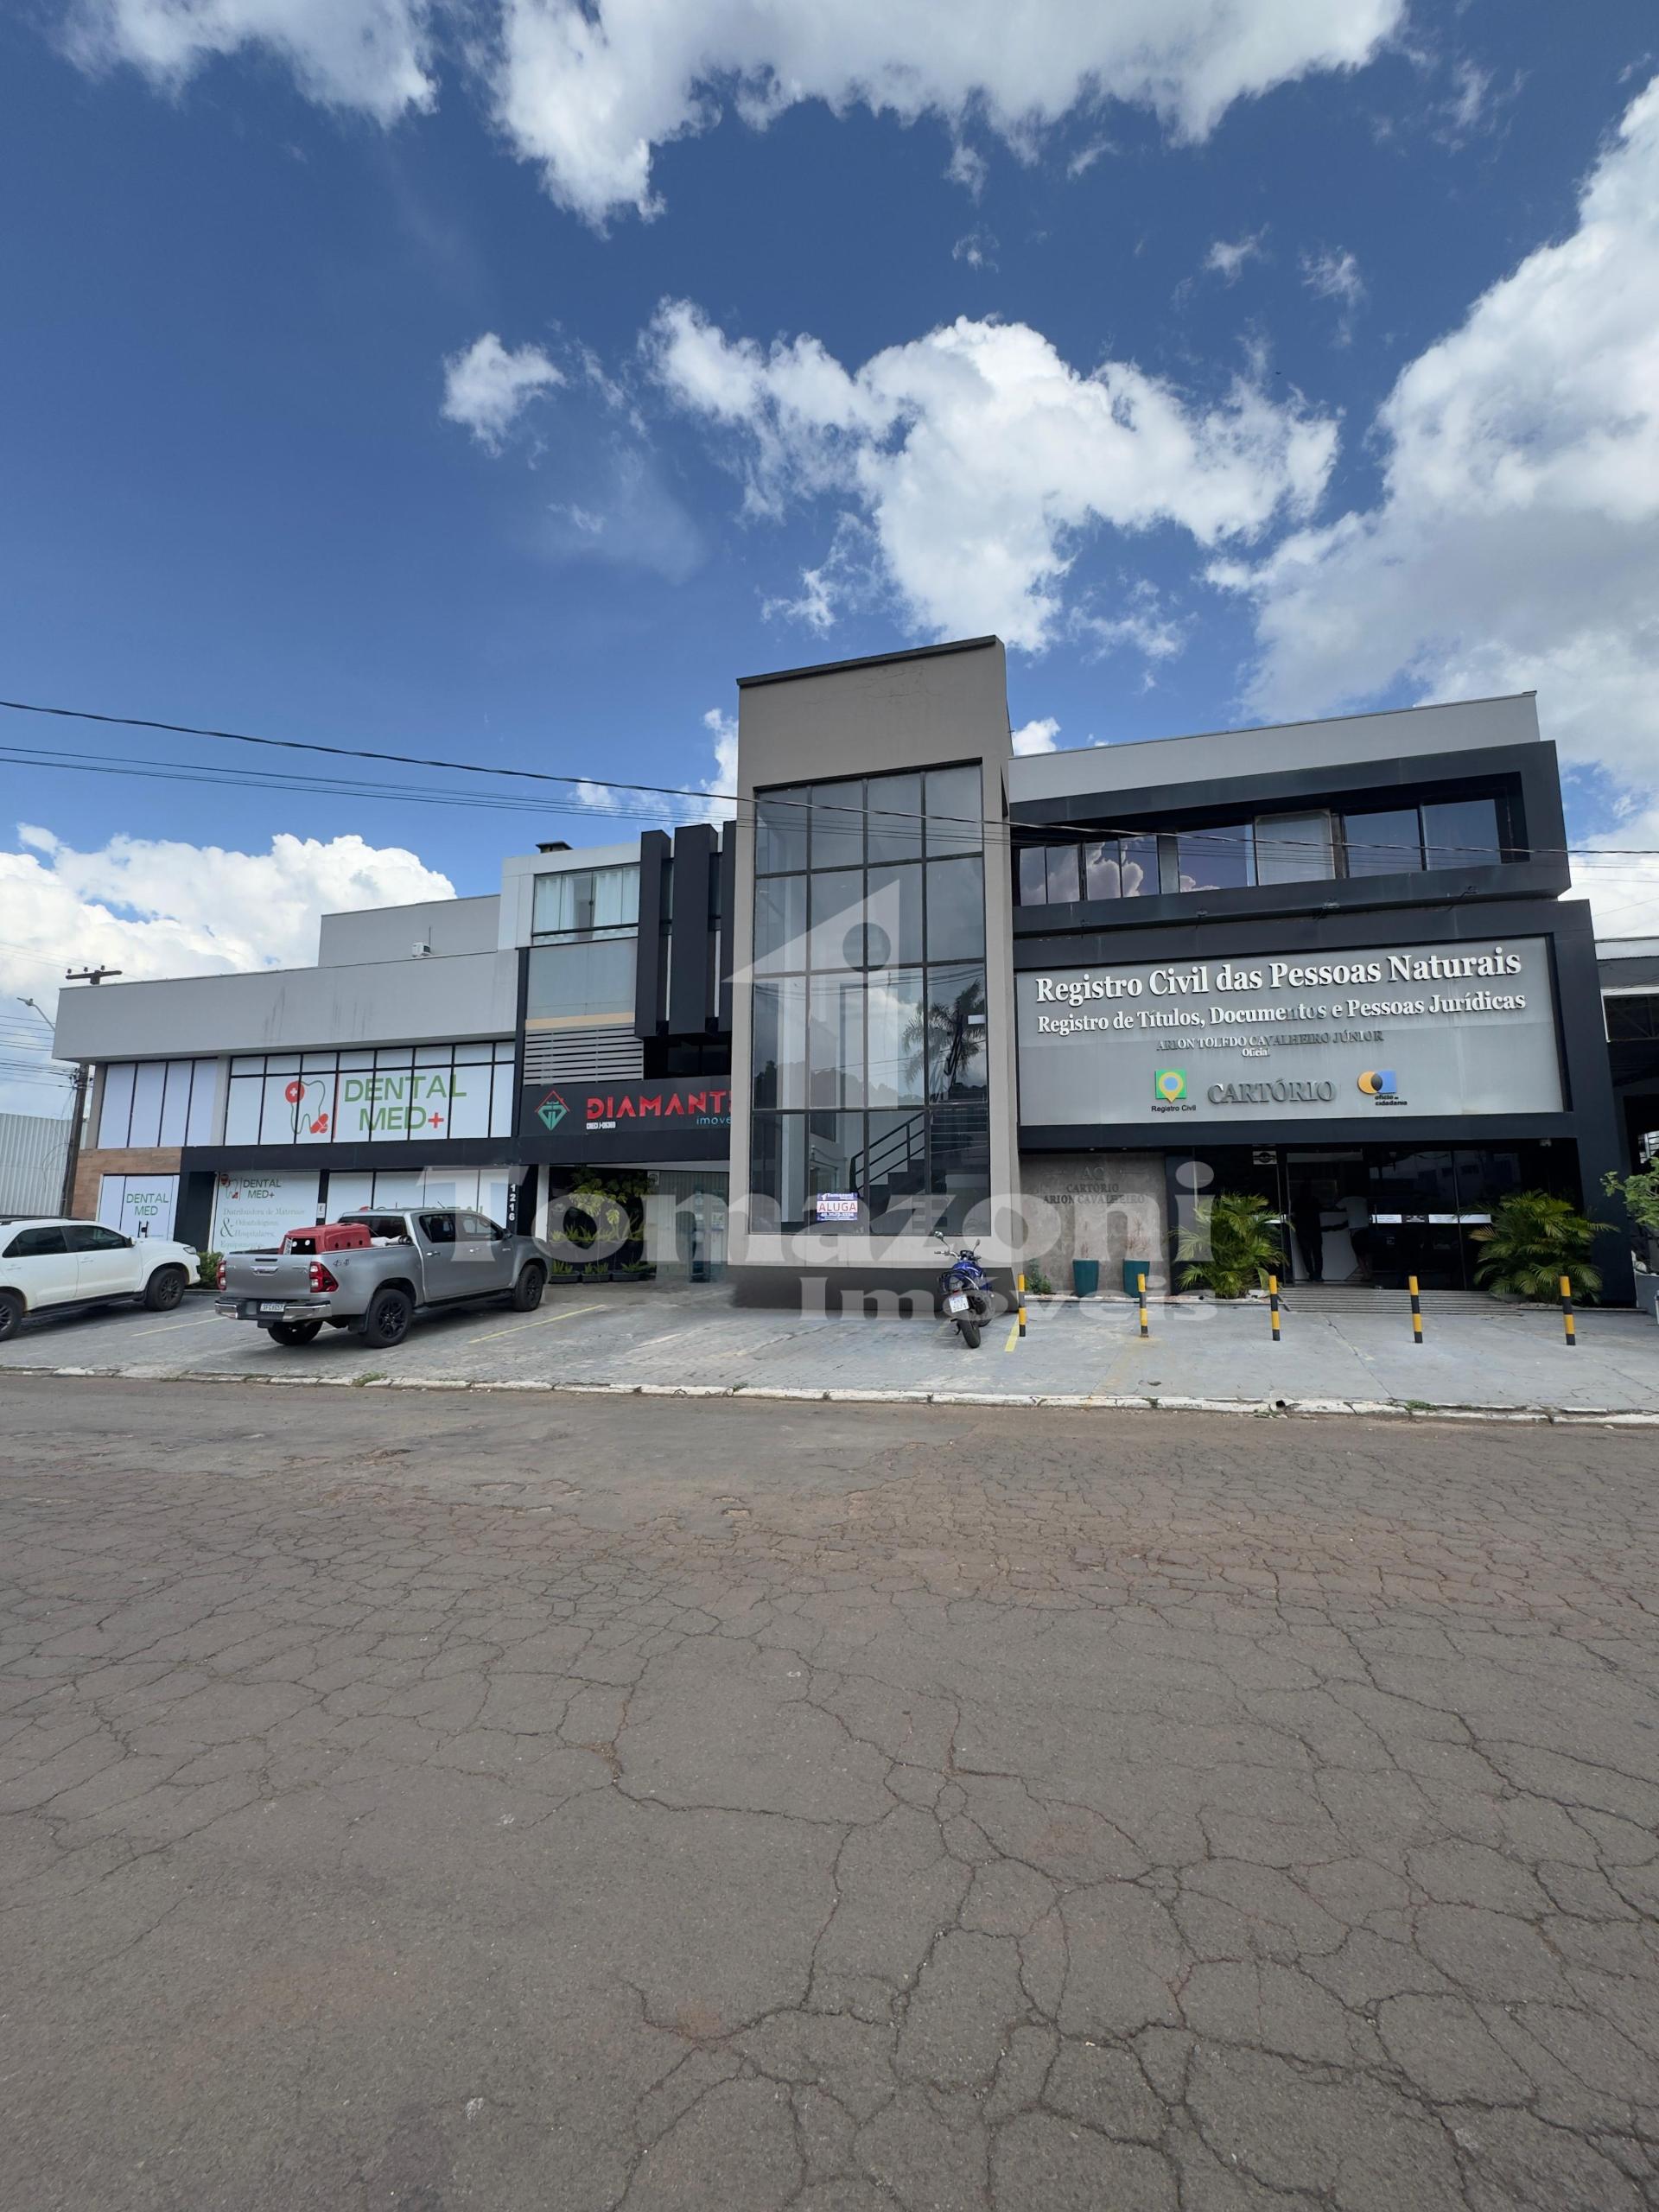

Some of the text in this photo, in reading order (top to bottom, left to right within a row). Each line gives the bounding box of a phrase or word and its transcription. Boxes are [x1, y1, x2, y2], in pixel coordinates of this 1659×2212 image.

[1036, 946, 1522, 1007] Registro Civil das Pessoas Naturais
[1038, 990, 1526, 1036] Registro de Títulos, Documentos e Pessoas Jurídicas
[1157, 1037, 1194, 1051] ARION
[1197, 1035, 1247, 1049] TOLEDO
[345, 1074, 467, 1102] DENTAL
[1208, 1077, 1337, 1104] CARTÓRIO
[587, 1090, 731, 1120] DIAMANT
[243, 1179, 282, 1188] DENTAL
[126, 1193, 168, 1203] DENTAL
[508, 1184, 517, 1221] 1216
[818, 1202, 856, 1211] ALUGA
[1043, 1194, 1074, 1204] ARION
[135, 1205, 158, 1216] MED
